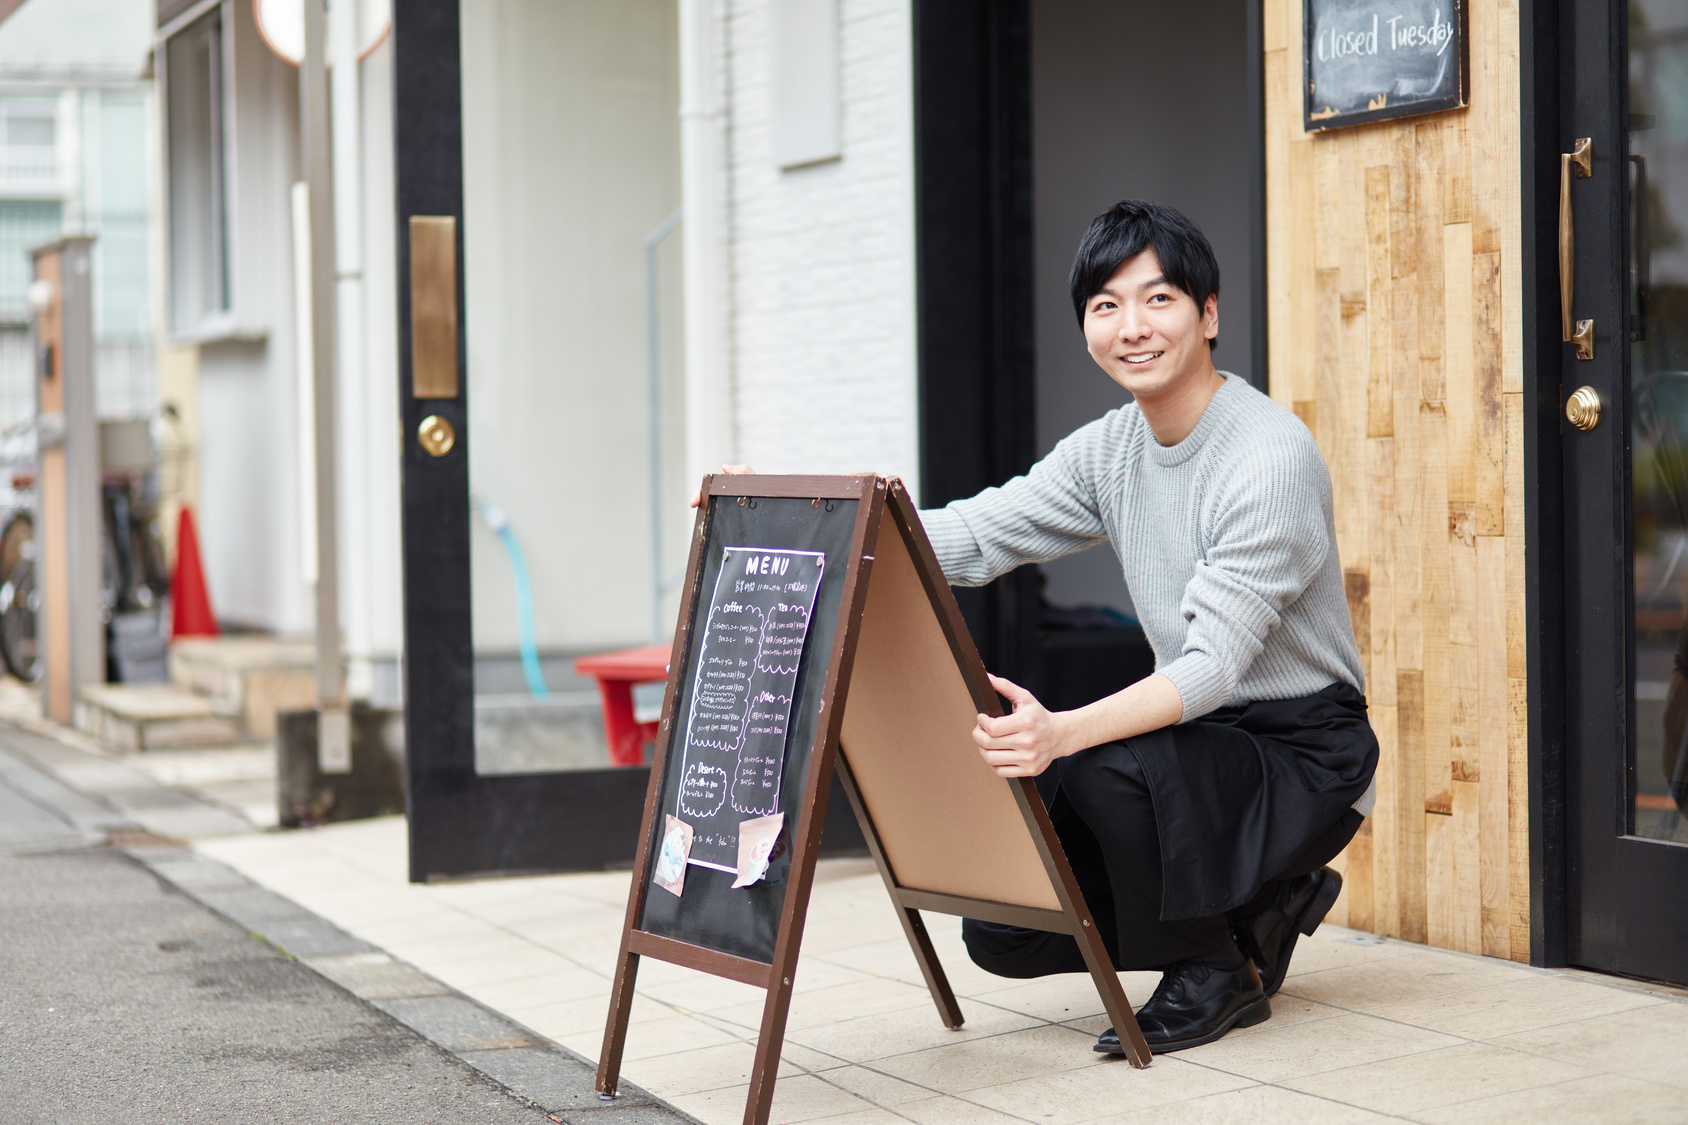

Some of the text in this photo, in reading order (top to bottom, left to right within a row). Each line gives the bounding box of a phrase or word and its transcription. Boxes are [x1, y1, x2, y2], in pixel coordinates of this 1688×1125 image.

[1318, 8, 1453, 62] Closed Tuesday
[745, 555, 790, 576] MENU
[723, 601, 743, 613] Coffee
[777, 602, 789, 612] Tea
[759, 690, 776, 703] Other
